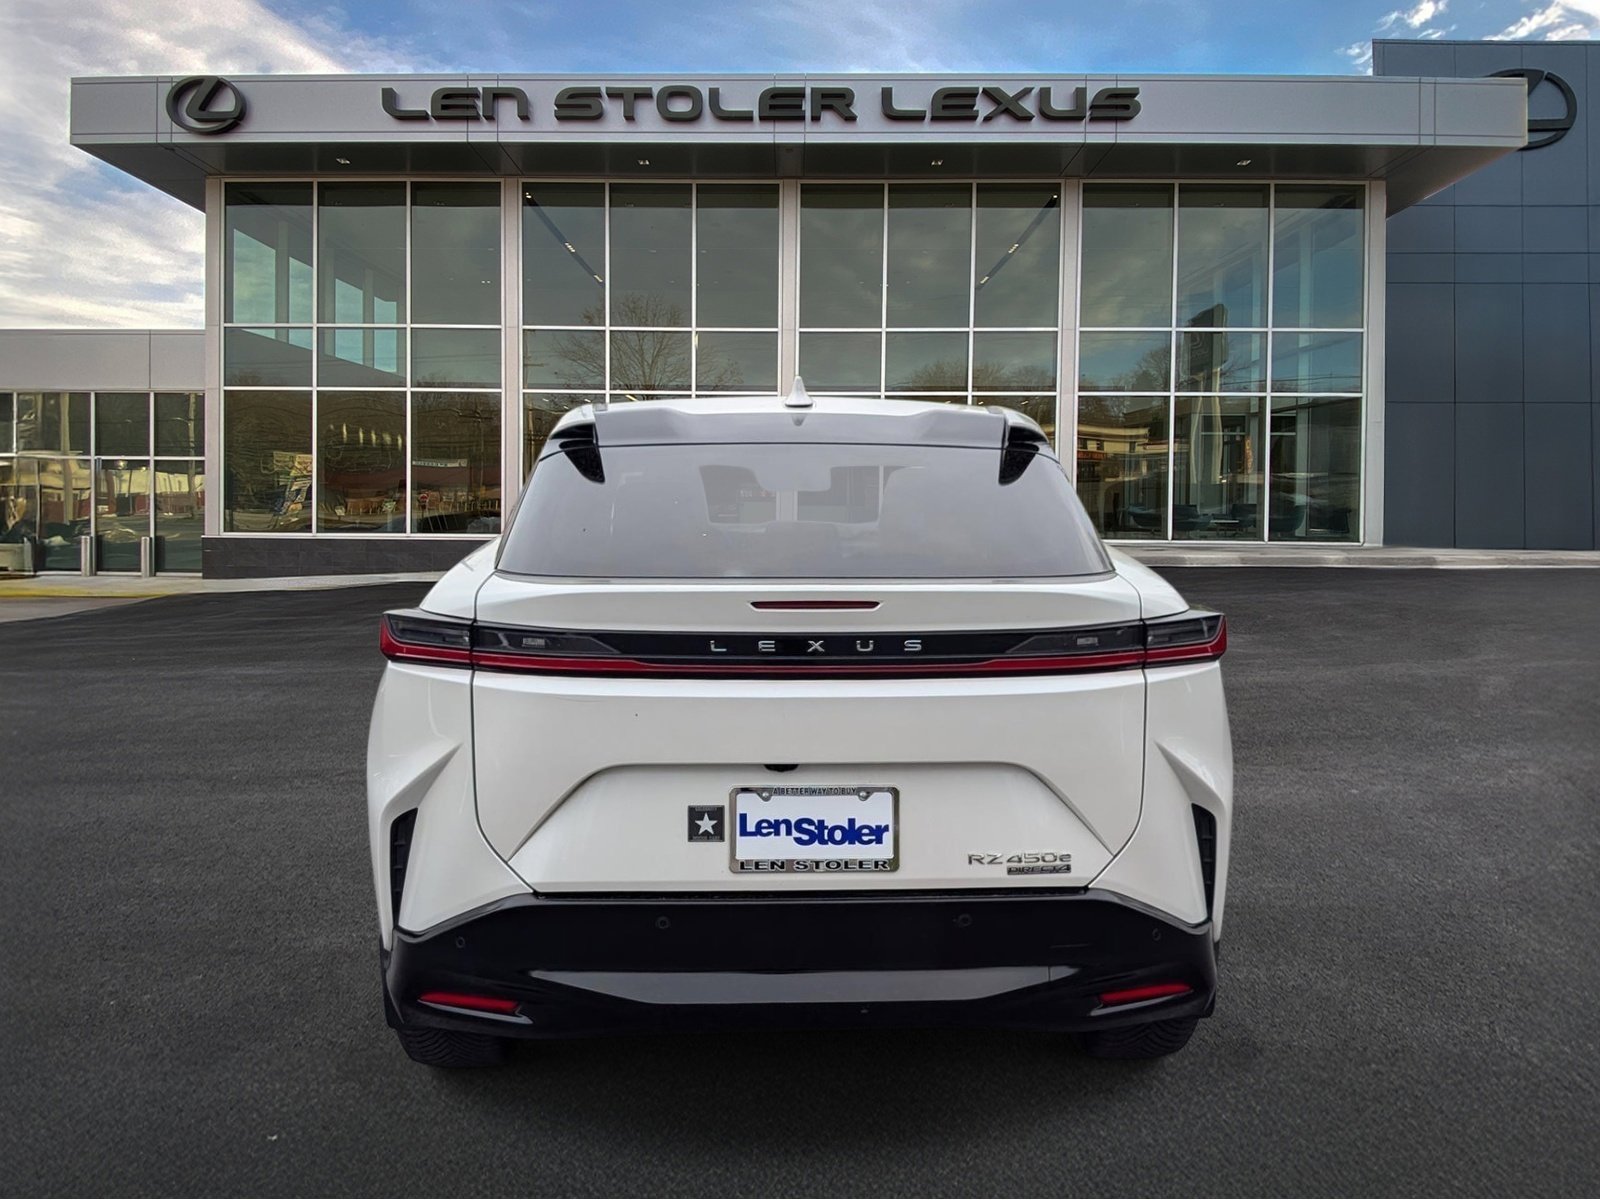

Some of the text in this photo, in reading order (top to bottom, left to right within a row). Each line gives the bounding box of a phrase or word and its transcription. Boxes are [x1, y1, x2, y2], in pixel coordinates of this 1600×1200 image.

[380, 85, 1142, 122] LEN STOLER LEXUS
[709, 639, 922, 652] LEXUS
[780, 787, 809, 796] BETTER
[810, 787, 827, 796] WAY
[828, 787, 839, 796] TO
[841, 787, 857, 796] BUY
[739, 859, 890, 870] LEN STOLER
